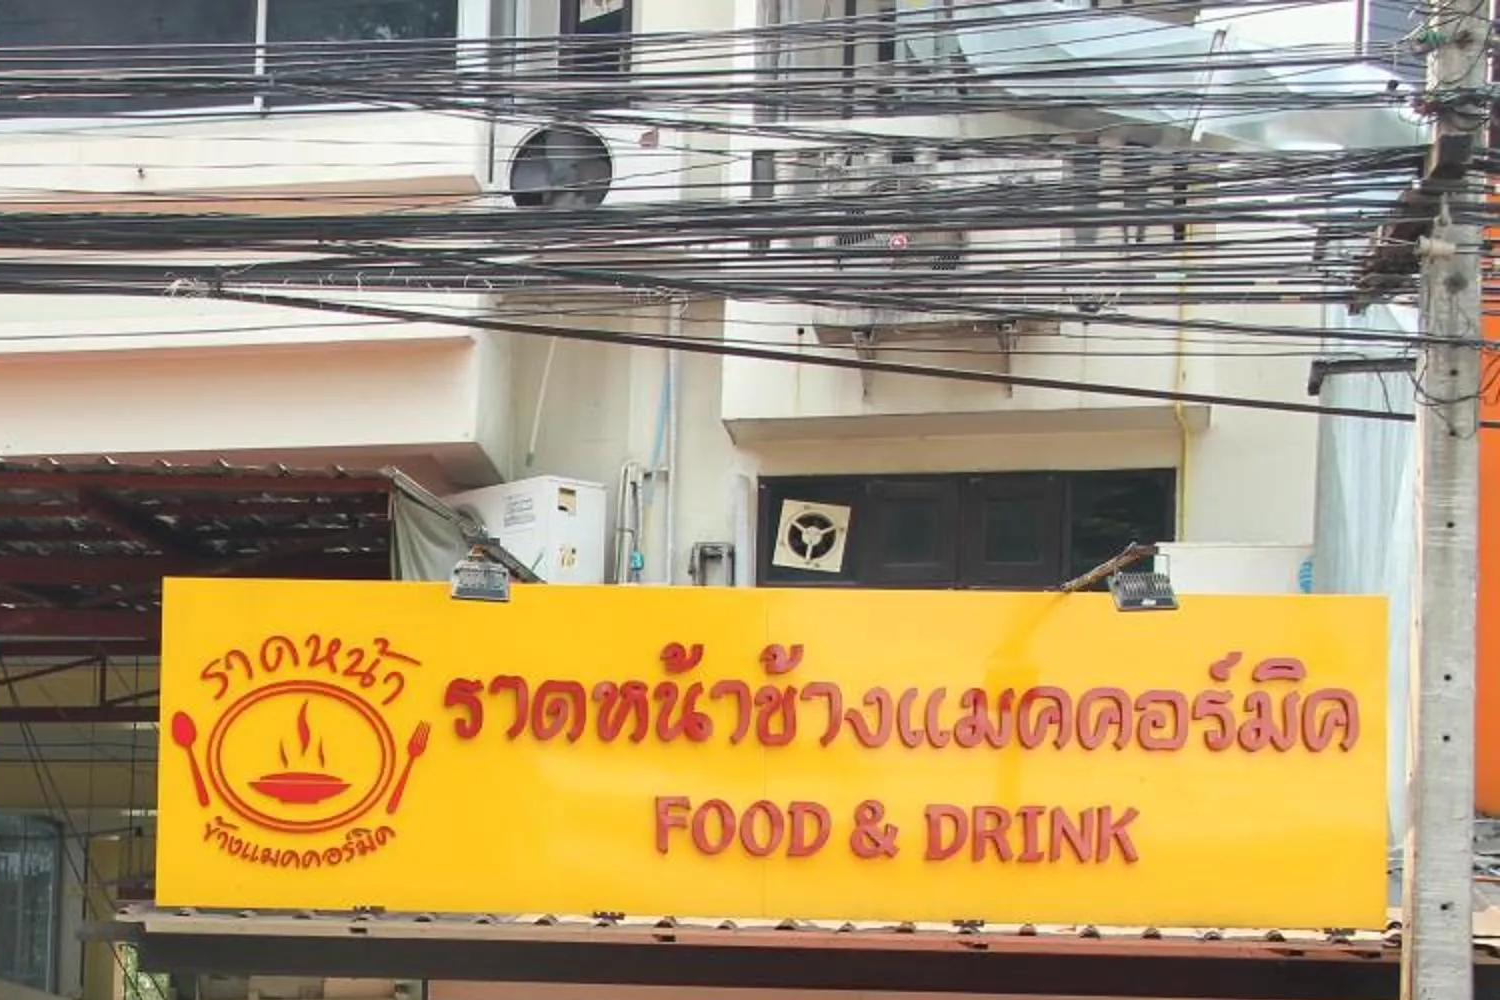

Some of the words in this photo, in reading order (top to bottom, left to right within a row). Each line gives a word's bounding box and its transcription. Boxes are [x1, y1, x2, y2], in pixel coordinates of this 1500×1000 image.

[200, 633, 422, 706] ราดหน้า
[655, 796, 832, 858] FOOD
[850, 799, 900, 859] &
[924, 803, 1140, 863] DRINK
